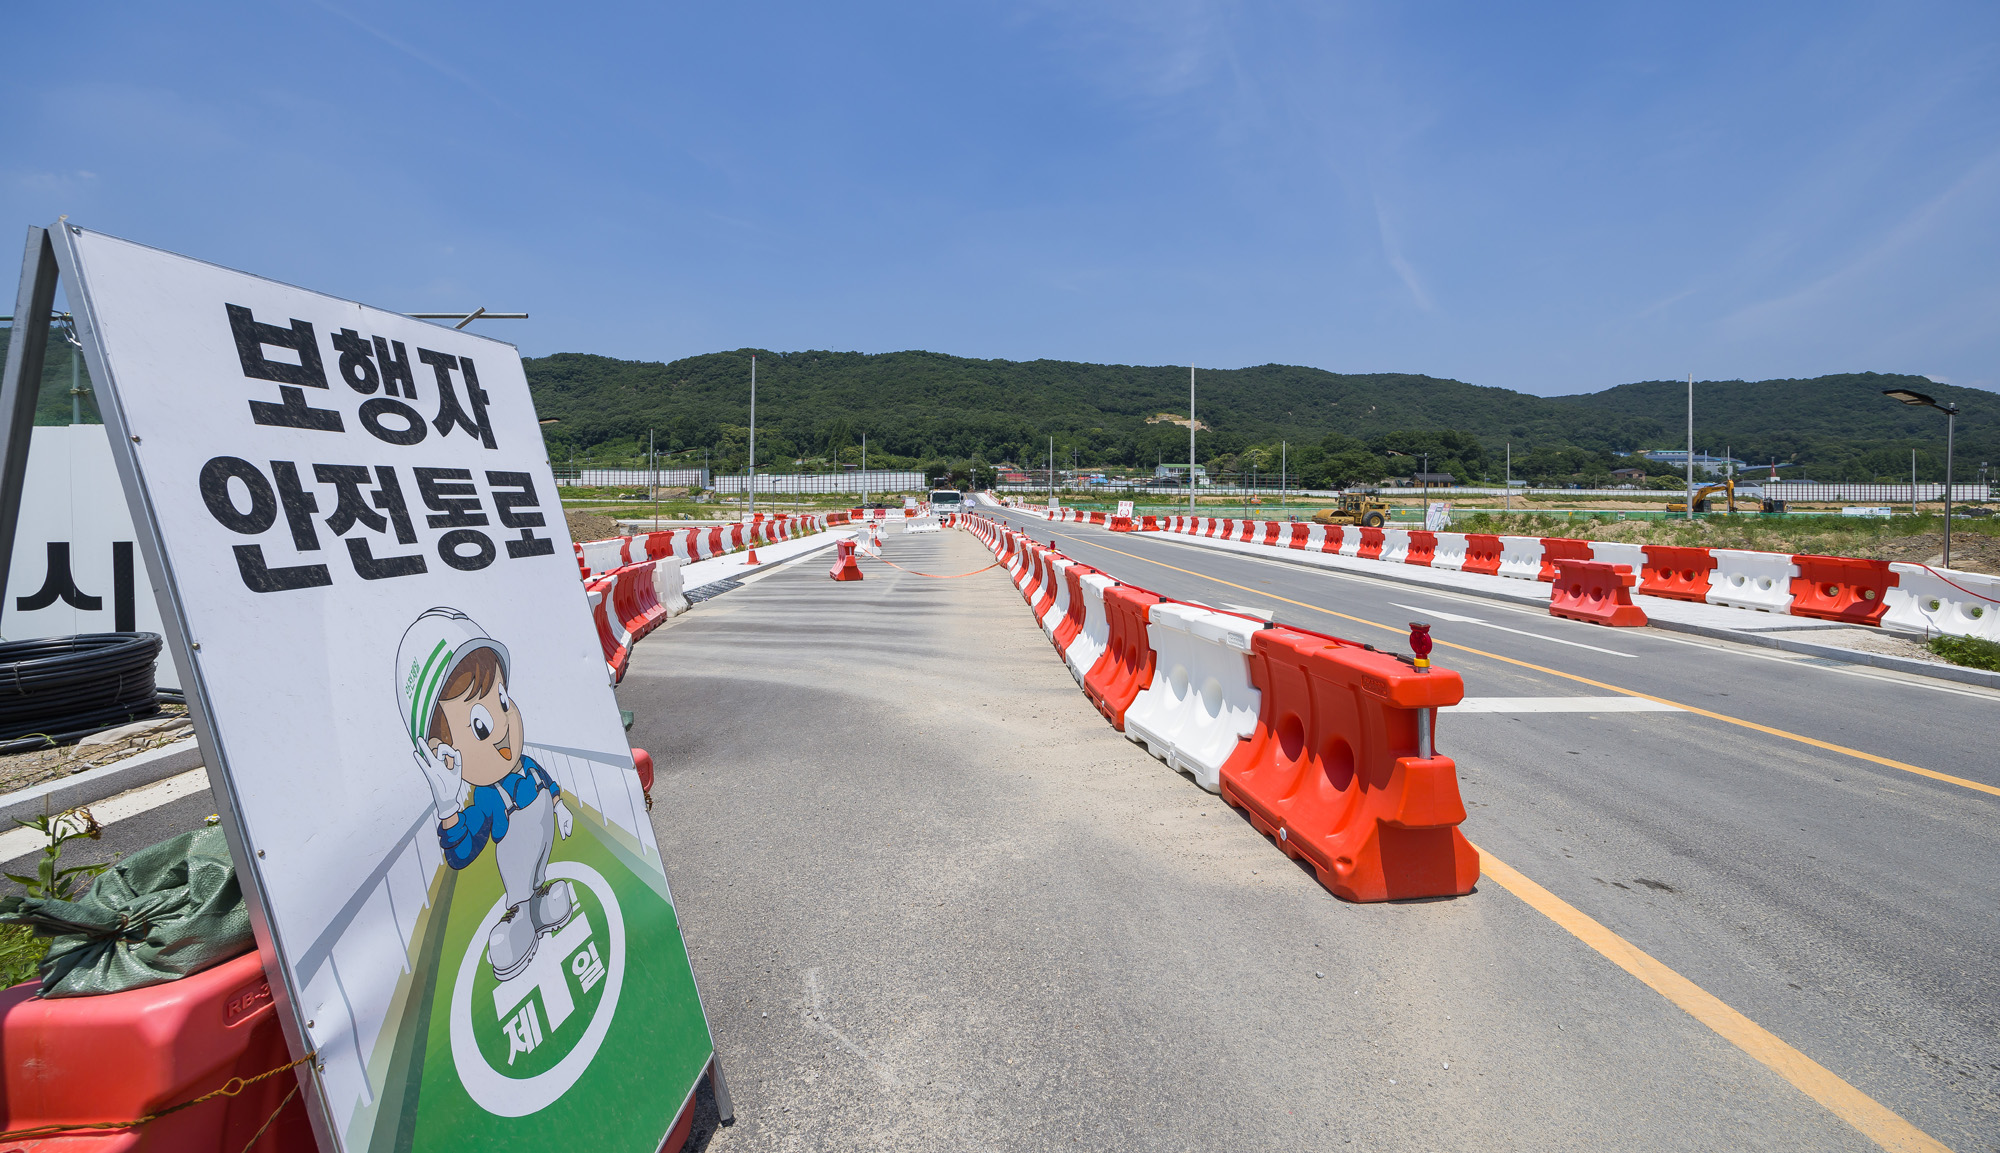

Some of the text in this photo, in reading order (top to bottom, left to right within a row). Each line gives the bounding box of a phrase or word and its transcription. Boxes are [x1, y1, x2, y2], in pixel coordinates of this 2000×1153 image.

[225, 303, 498, 449] 보행자
[199, 455, 555, 593] 안전통로
[572, 940, 606, 994] 일
[502, 999, 543, 1066] 제
